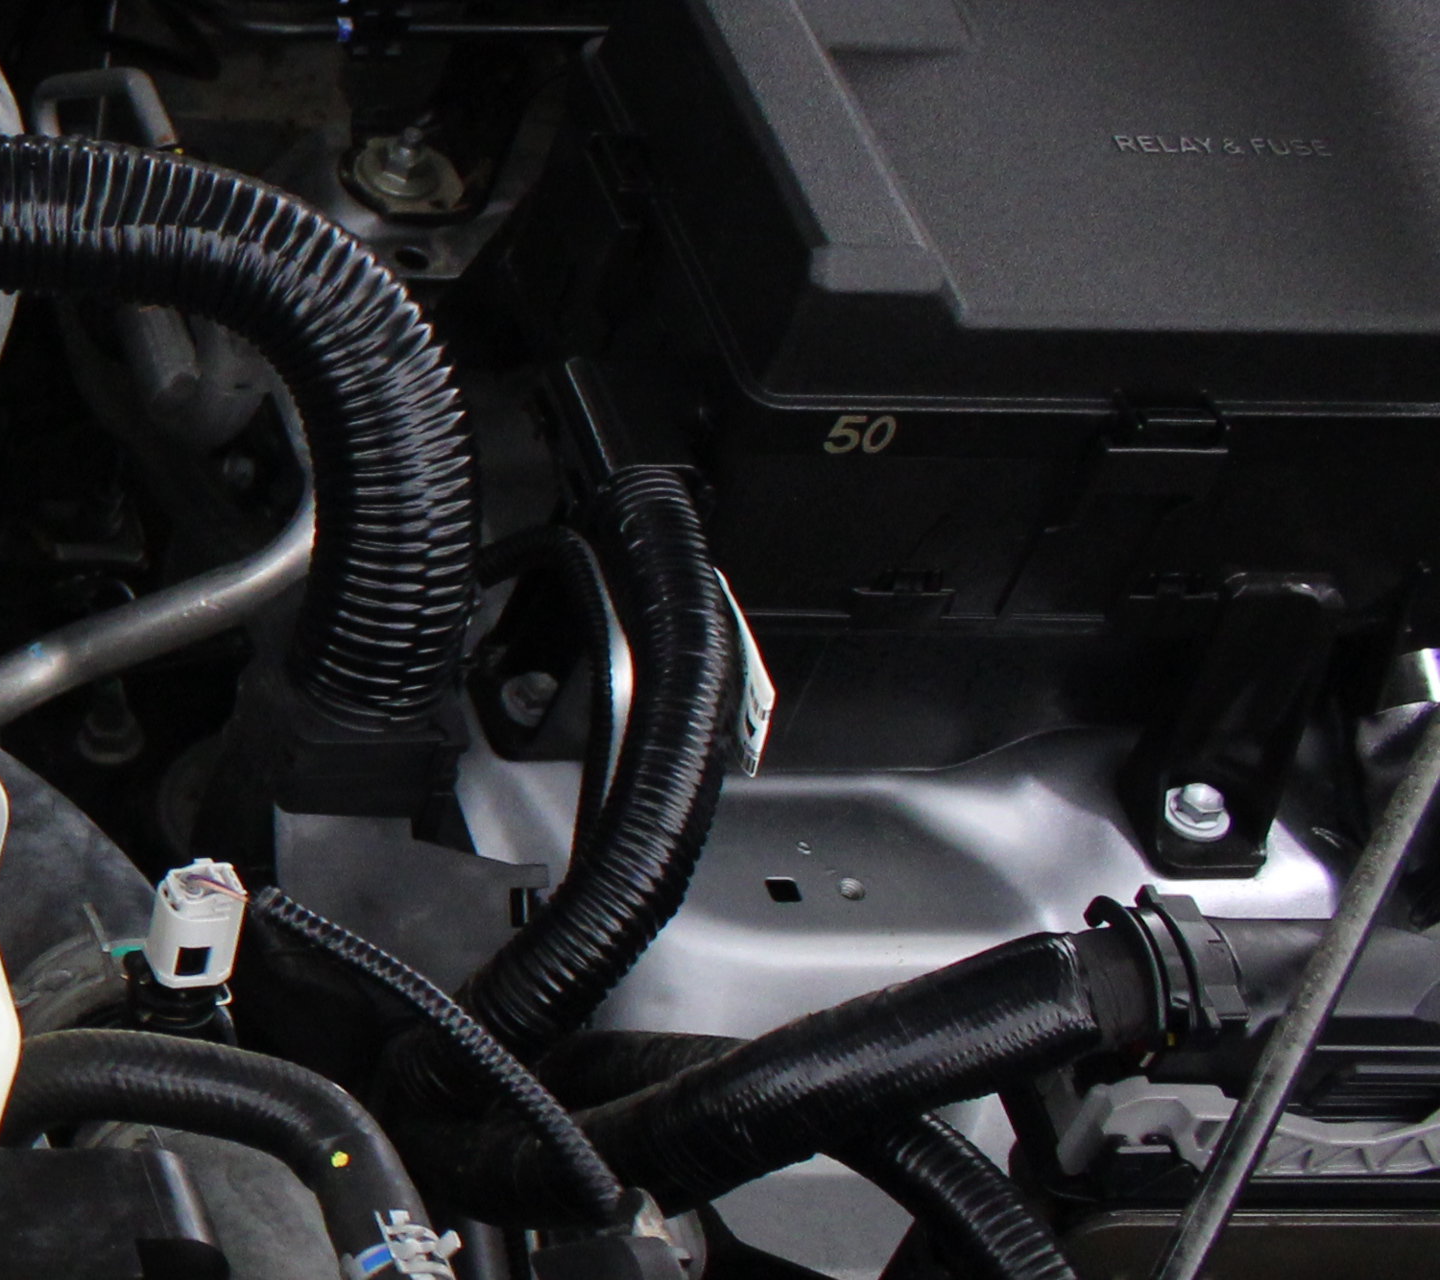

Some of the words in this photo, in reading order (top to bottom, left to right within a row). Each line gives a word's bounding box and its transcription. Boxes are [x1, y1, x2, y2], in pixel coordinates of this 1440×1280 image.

[1113, 134, 1216, 157] RELAY
[1222, 135, 1245, 157] &
[1251, 136, 1334, 158] FUSE
[822, 414, 898, 455] 50
